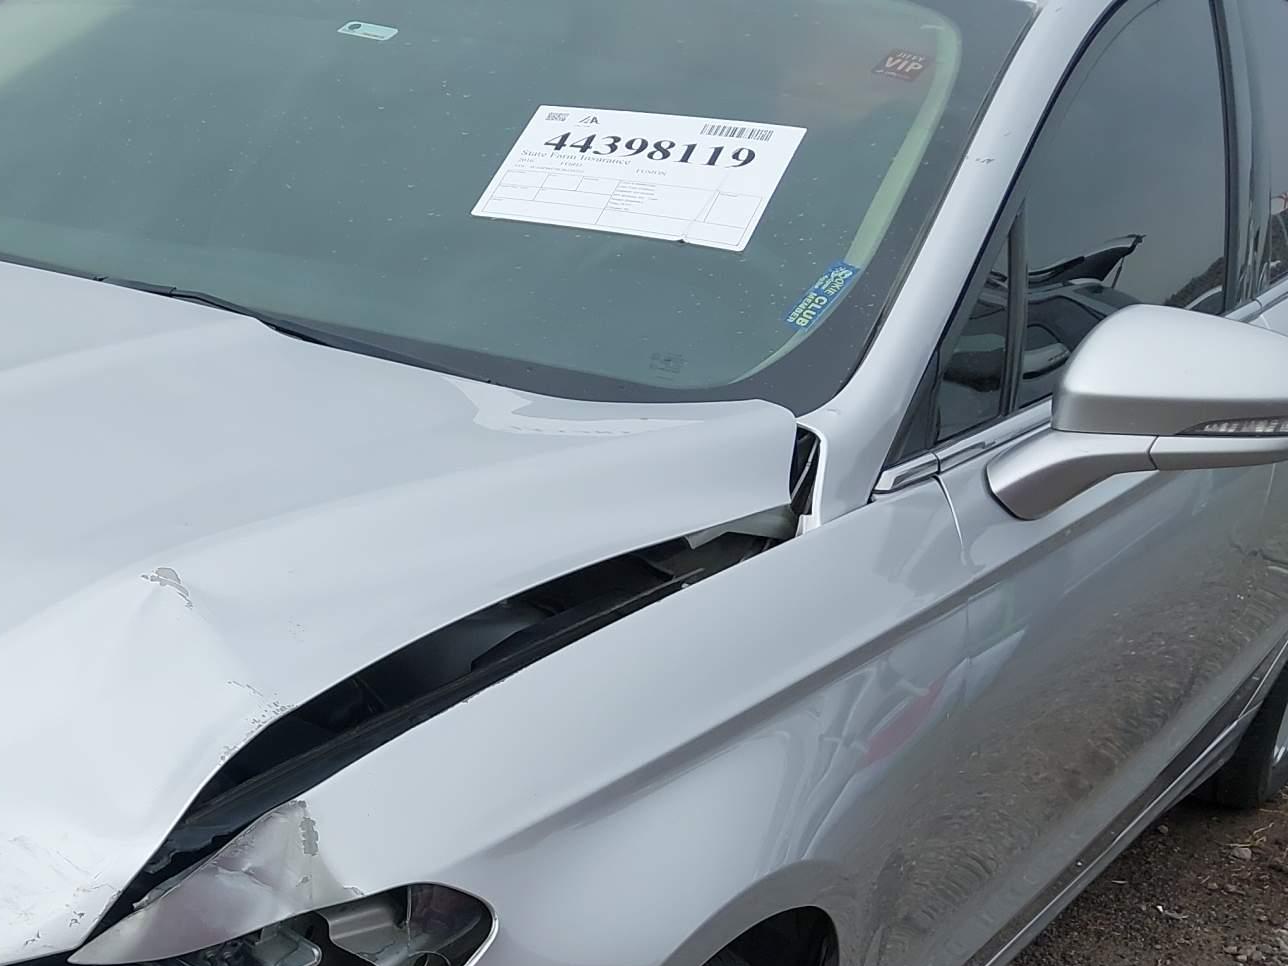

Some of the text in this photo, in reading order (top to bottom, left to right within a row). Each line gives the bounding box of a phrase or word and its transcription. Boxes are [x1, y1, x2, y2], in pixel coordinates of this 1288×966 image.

[885, 56, 923, 72] VIP
[520, 149, 632, 165] State Farm Insurance
[544, 131, 757, 169] 44398119
[786, 291, 817, 322] MEMBER
[795, 296, 828, 326] CLUB
